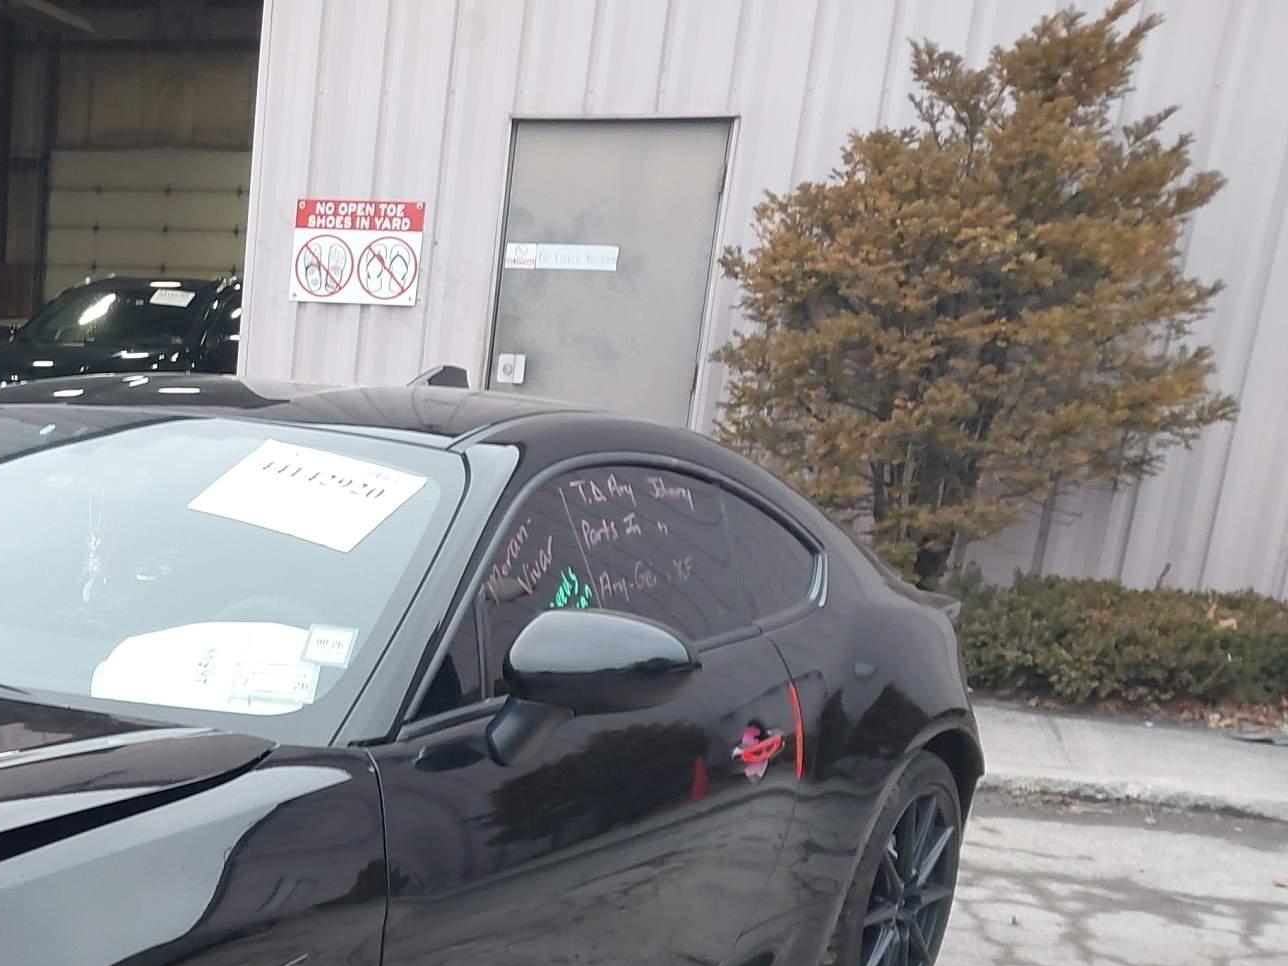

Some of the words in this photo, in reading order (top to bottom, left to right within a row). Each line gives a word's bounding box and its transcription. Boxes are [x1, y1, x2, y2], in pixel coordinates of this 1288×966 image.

[316, 202, 334, 215] NO
[339, 202, 375, 216] OPEN
[379, 203, 405, 217] TOE
[308, 215, 351, 229] SHOES
[356, 216, 369, 229] IN
[375, 217, 411, 230] YARD
